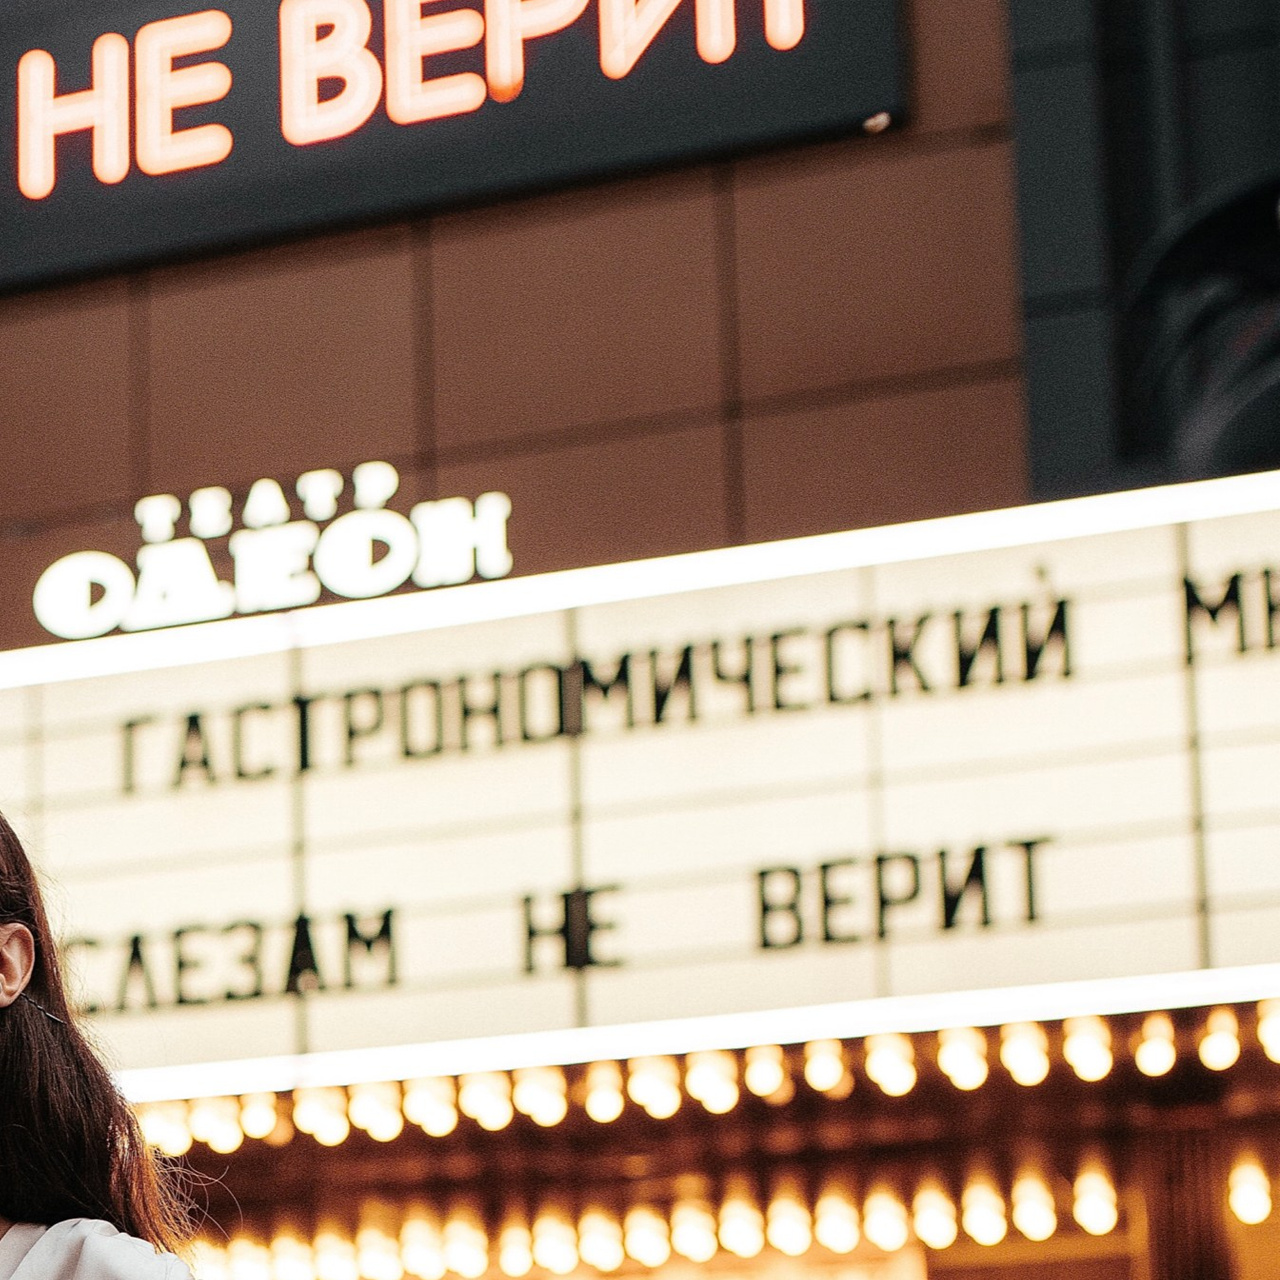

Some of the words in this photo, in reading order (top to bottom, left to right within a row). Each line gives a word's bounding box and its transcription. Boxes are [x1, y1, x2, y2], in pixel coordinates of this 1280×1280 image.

[17, 8, 234, 201] НЕ
[120, 566, 1074, 796] ГАСТРОНОМИЧЕСКИЙ
[521, 884, 627, 977] НЕ
[756, 837, 1056, 953] ВЕРИТ
